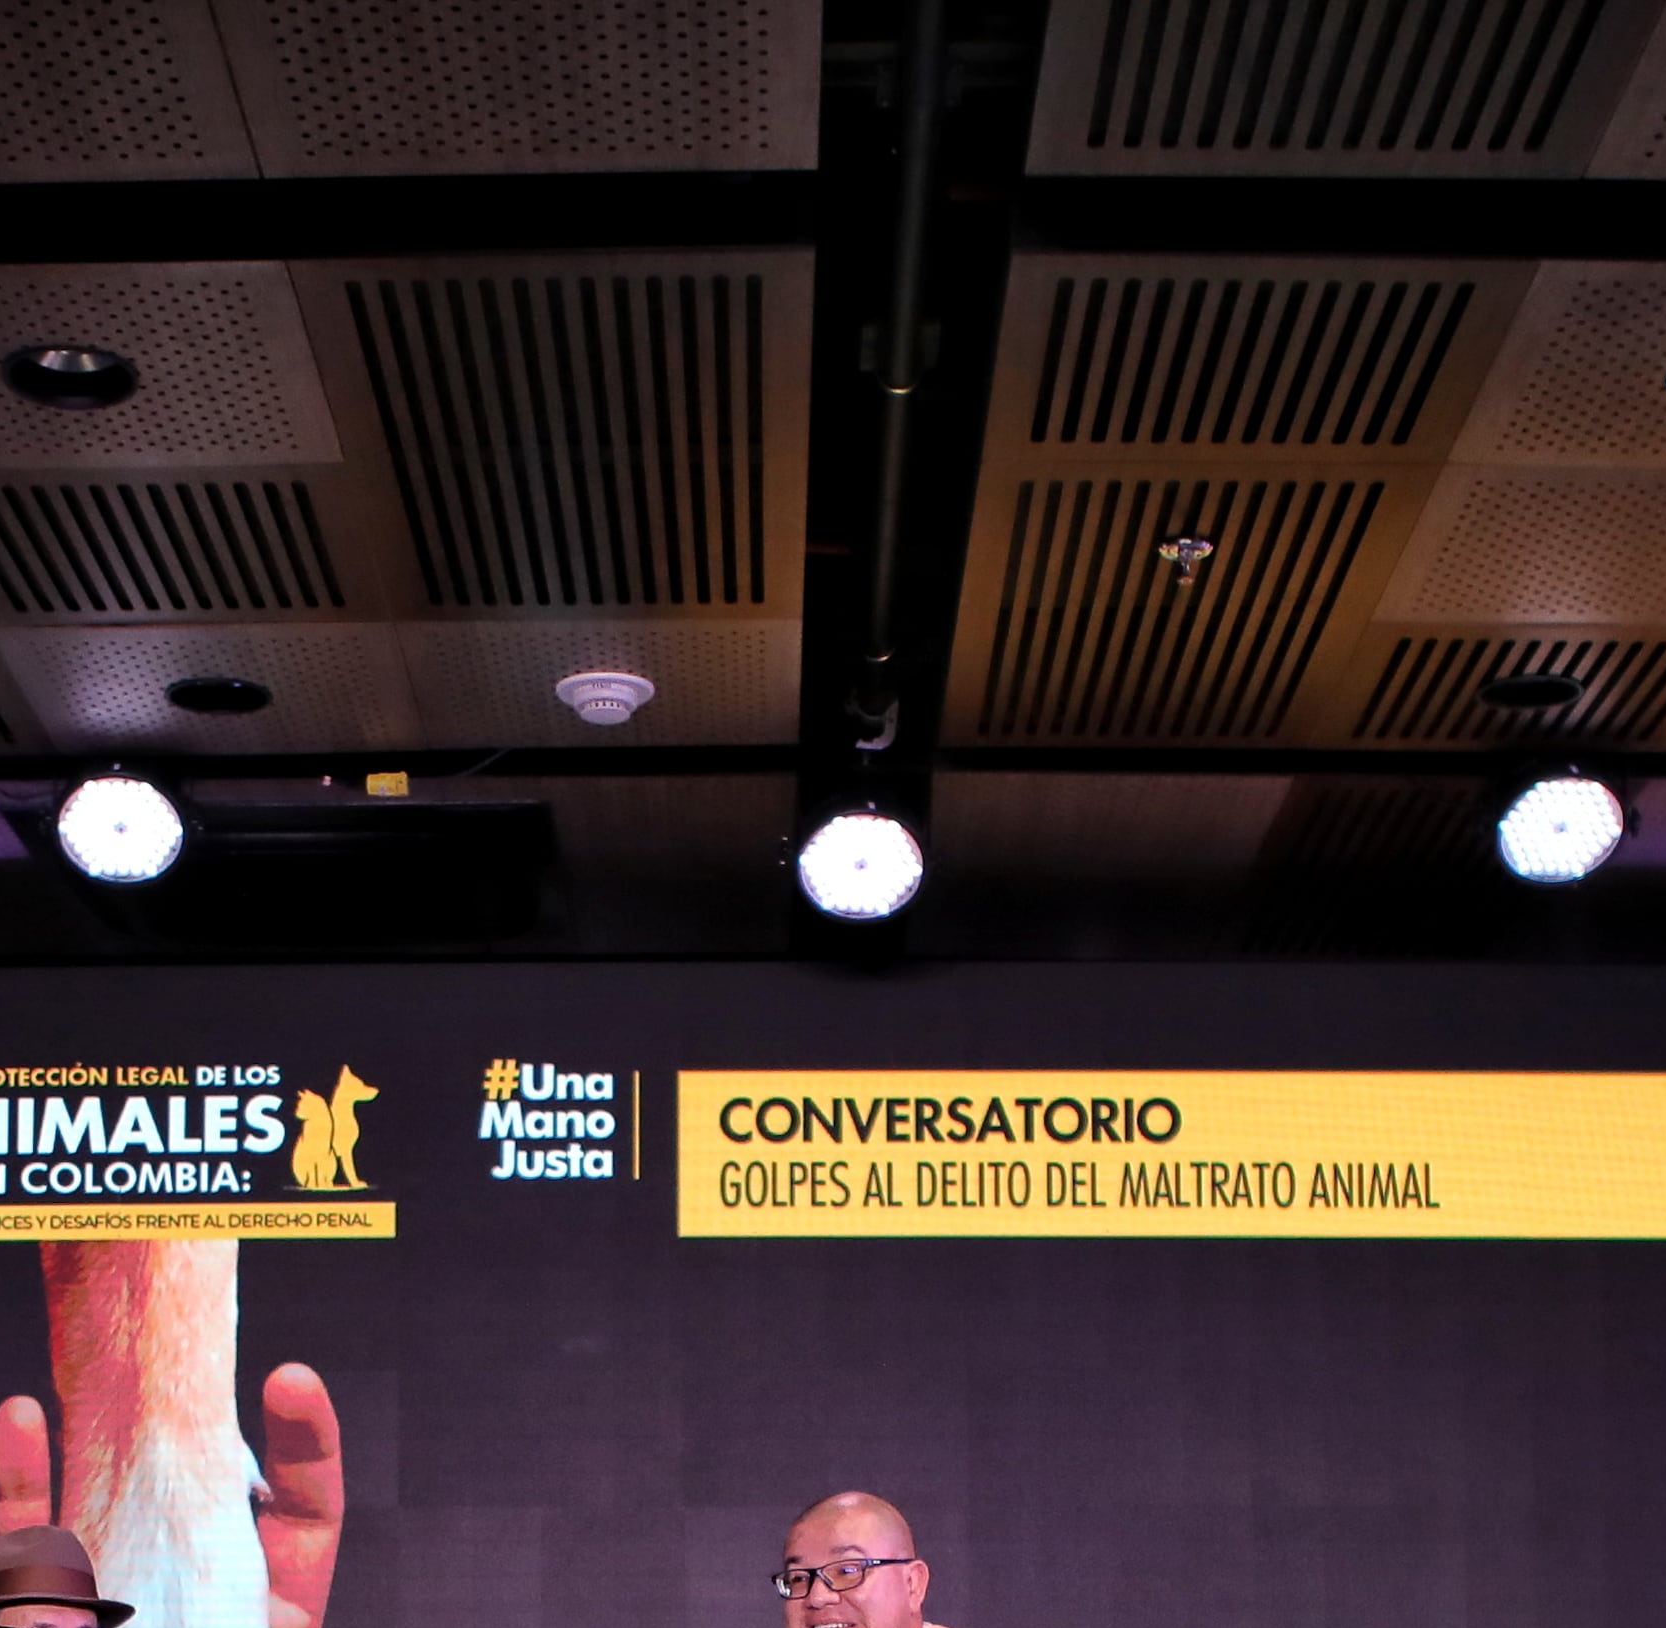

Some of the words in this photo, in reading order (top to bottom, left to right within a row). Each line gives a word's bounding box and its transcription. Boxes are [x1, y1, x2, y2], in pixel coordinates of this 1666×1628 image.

[116, 1066, 190, 1087] LEGAL
[195, 1066, 228, 1086] DE
[233, 1065, 281, 1086] LOS
[483, 1058, 614, 1100] #Una
[478, 1101, 616, 1139] Mano
[719, 1096, 1182, 1143] CONVERSATORIO
[20, 1160, 252, 1194] COLOMBIA:
[490, 1140, 614, 1180] Justa
[719, 1160, 851, 1208] GOLPES
[863, 1162, 903, 1208] AL
[917, 1161, 1030, 1208] DELITO
[1046, 1162, 1106, 1208] DEL
[1119, 1162, 1296, 1209] MALTRATO
[1308, 1163, 1440, 1209] ANIMAL
[35, 1215, 47, 1229] Y
[50, 1210, 132, 1230] DESAFÍOS
[136, 1213, 201, 1229] FRENTE
[204, 1213, 226, 1228] AL
[229, 1212, 313, 1228] DERECHO
[315, 1211, 373, 1228] PENAL
